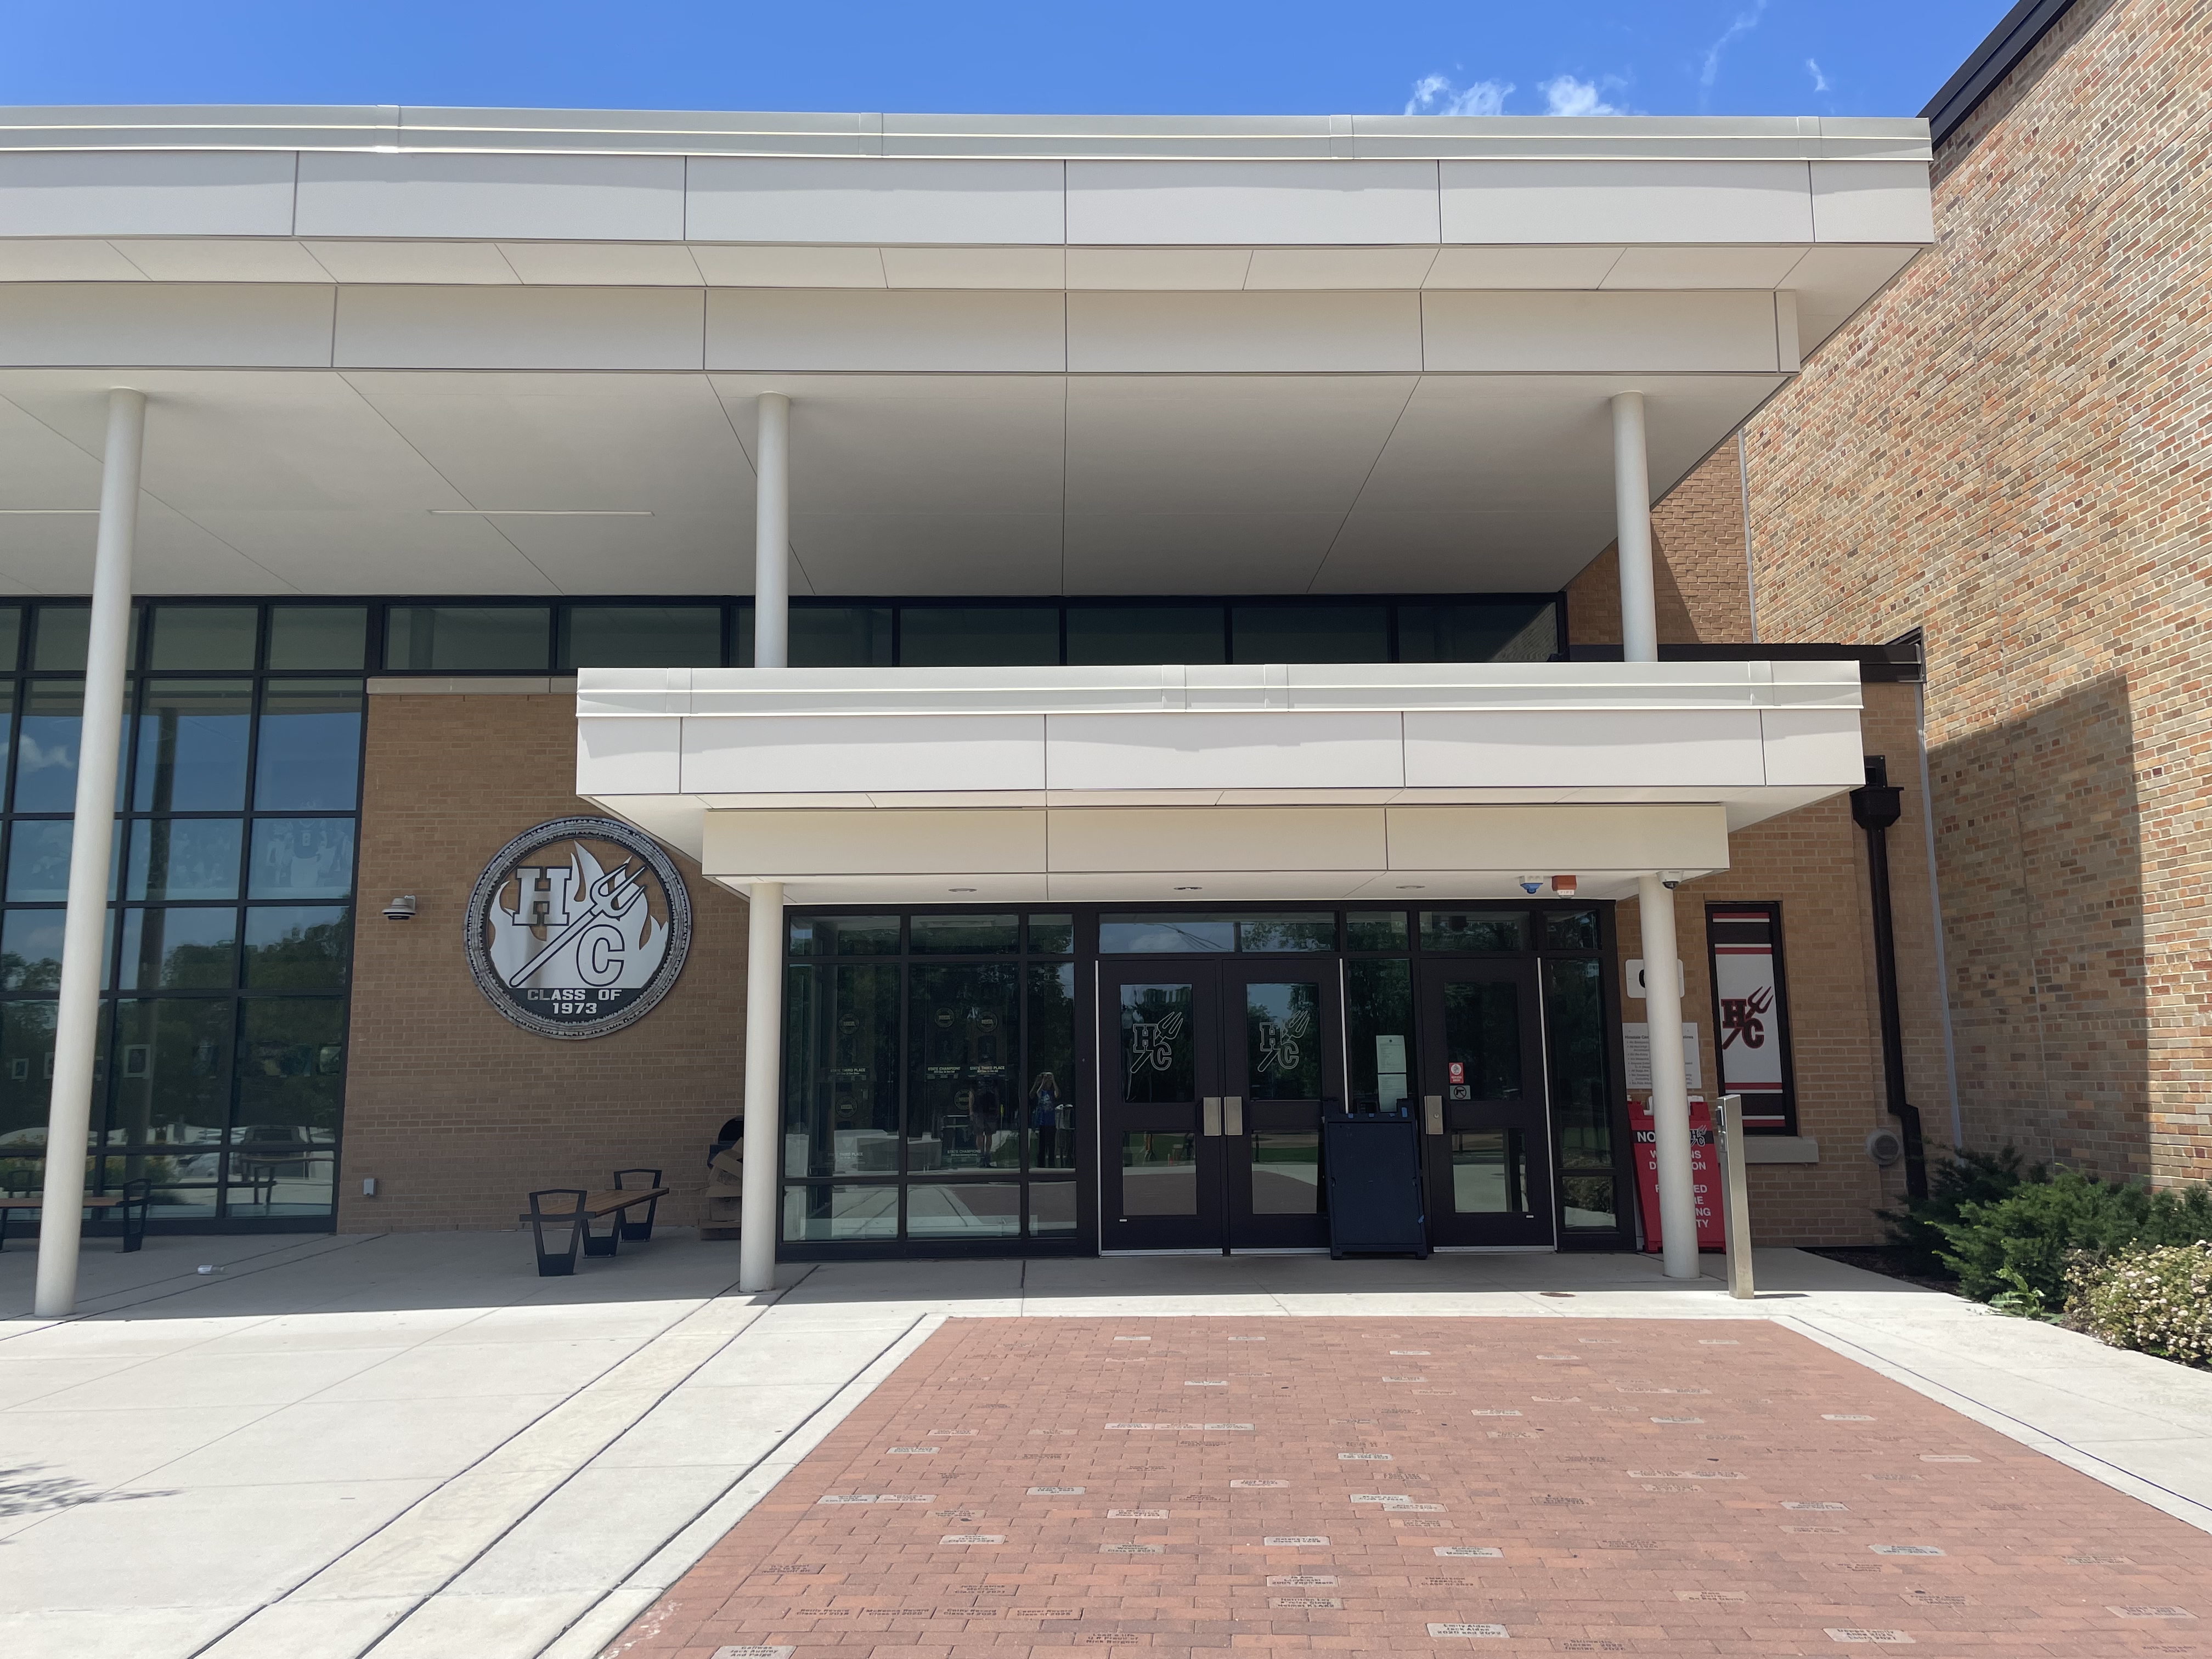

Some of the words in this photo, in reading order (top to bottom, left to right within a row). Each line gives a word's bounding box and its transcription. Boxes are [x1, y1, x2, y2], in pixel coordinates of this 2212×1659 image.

[527, 989, 586, 1000] CLASS
[598, 989, 622, 1000] OF
[552, 1003, 597, 1014] 1973
